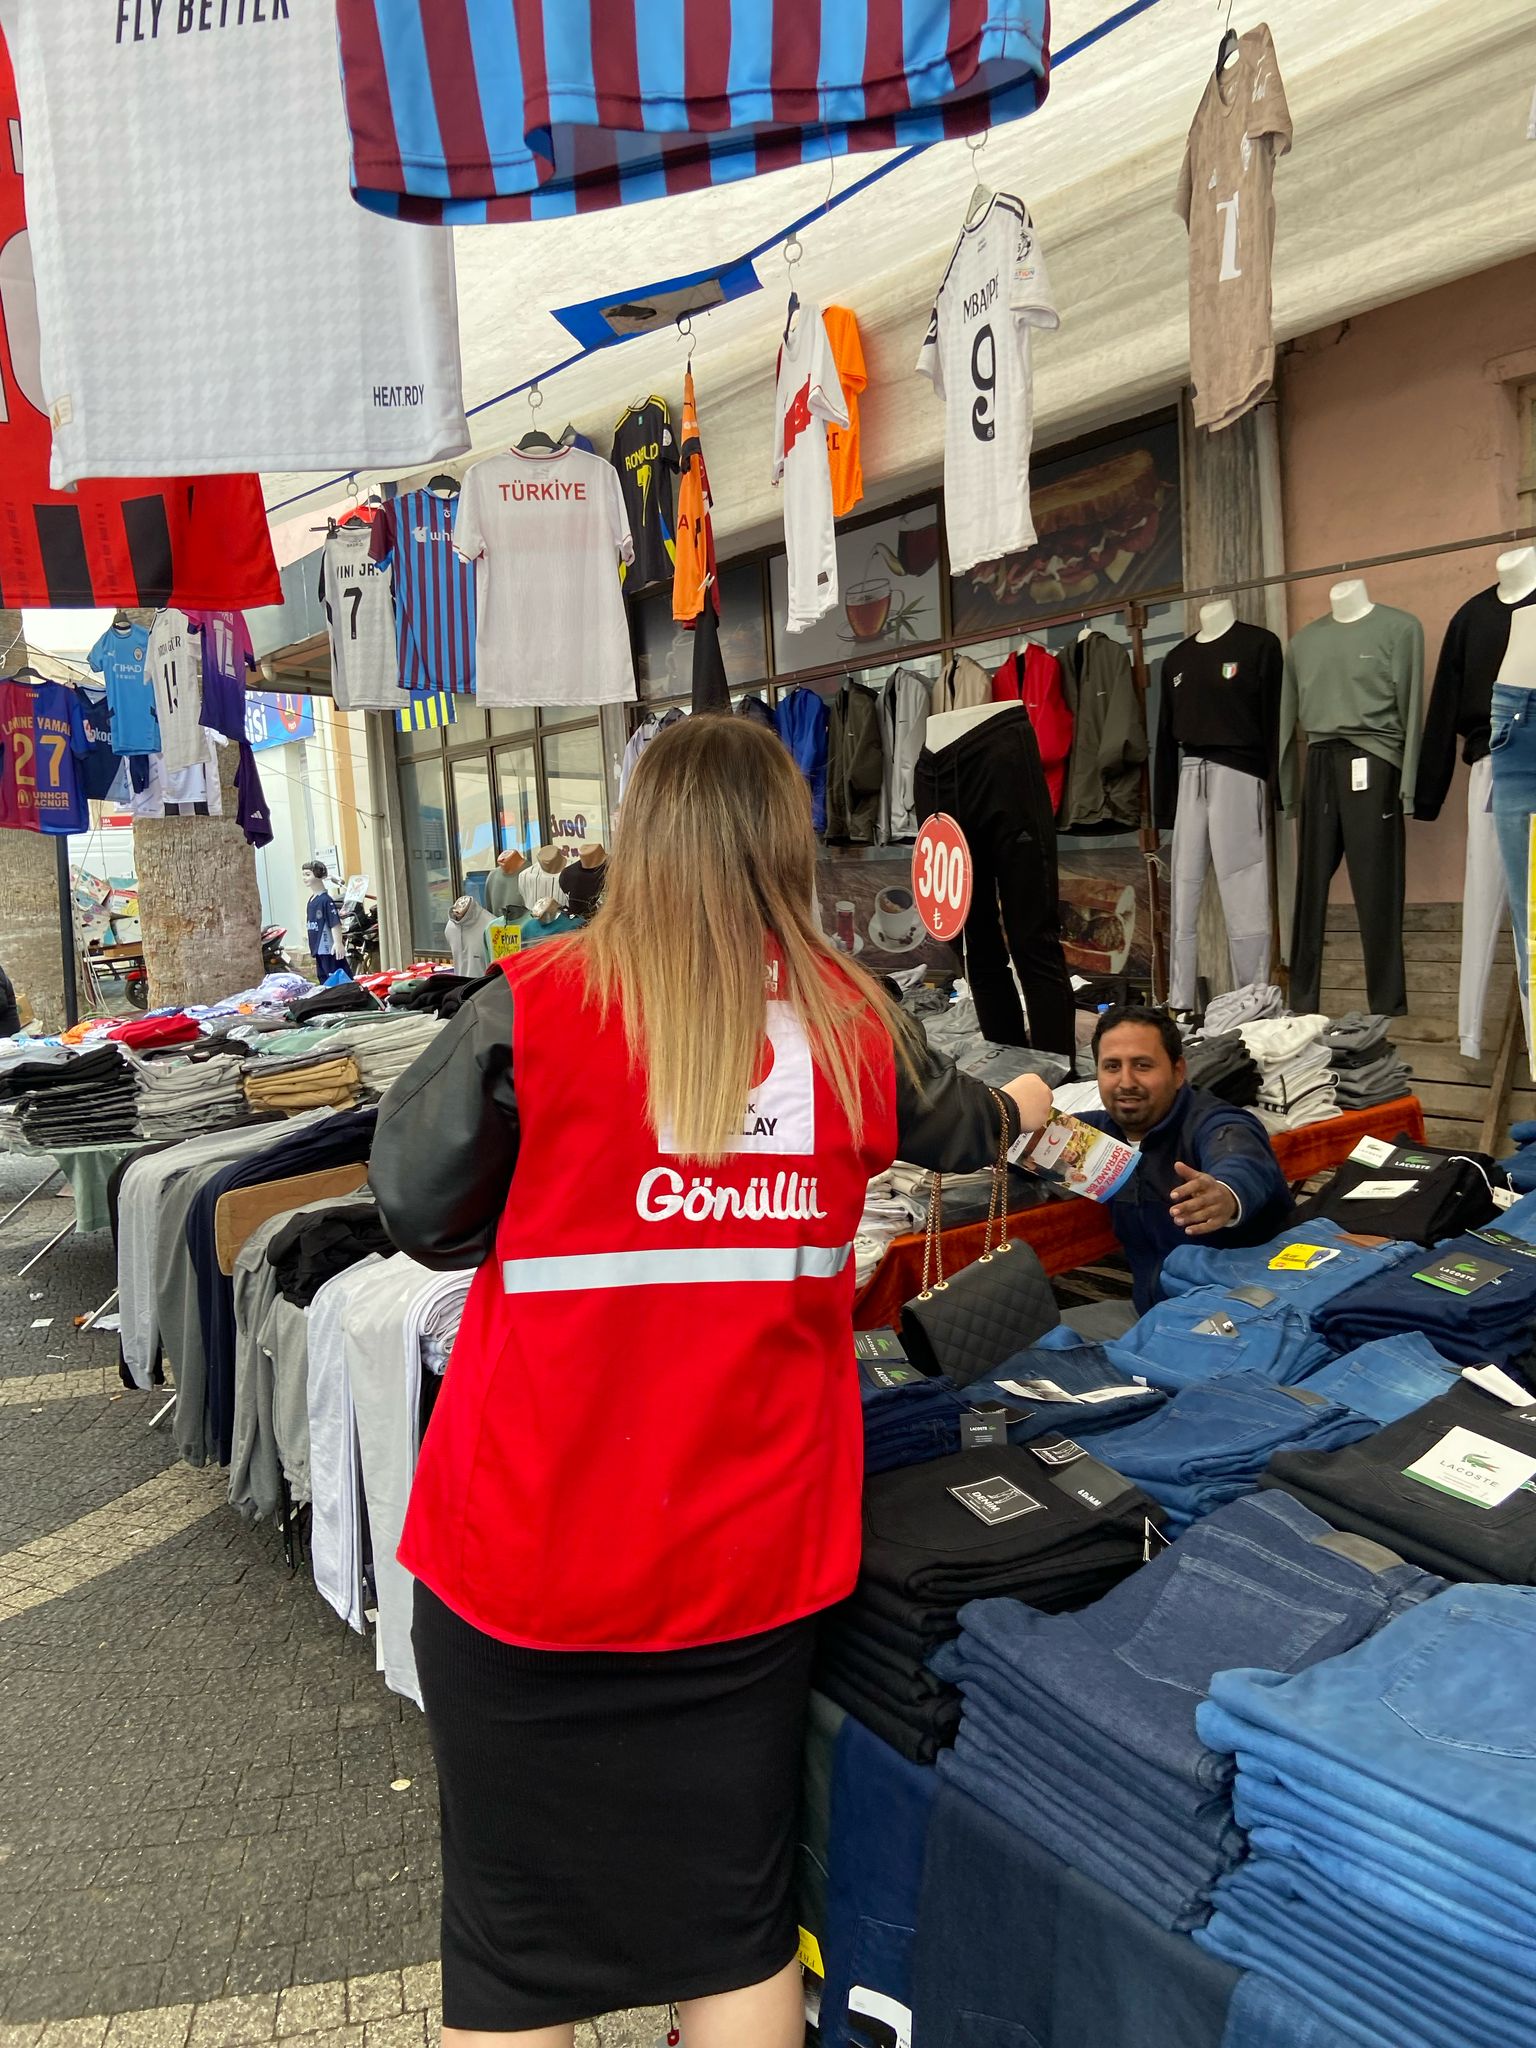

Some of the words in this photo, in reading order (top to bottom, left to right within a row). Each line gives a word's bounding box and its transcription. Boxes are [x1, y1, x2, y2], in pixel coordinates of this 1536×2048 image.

[116, 0, 163, 43] FLY
[971, 323, 996, 441] 9
[373, 384, 424, 407] HEAT.RDY
[499, 479, 586, 501] TÜRKİYE
[344, 587, 362, 639] 7
[13, 733, 66, 787] 27
[918, 836, 964, 910] 300
[1394, 1160, 1431, 1170] LACOSTE
[637, 1166, 827, 1222] Gönüllü
[1439, 1266, 1476, 1282] LACOSTE
[864, 1334, 879, 1356] LACOSTE
[874, 1367, 895, 1386] LACOSTE
[1439, 1459, 1500, 1488] LACOSTE
[971, 1491, 1001, 1513] DENIM
